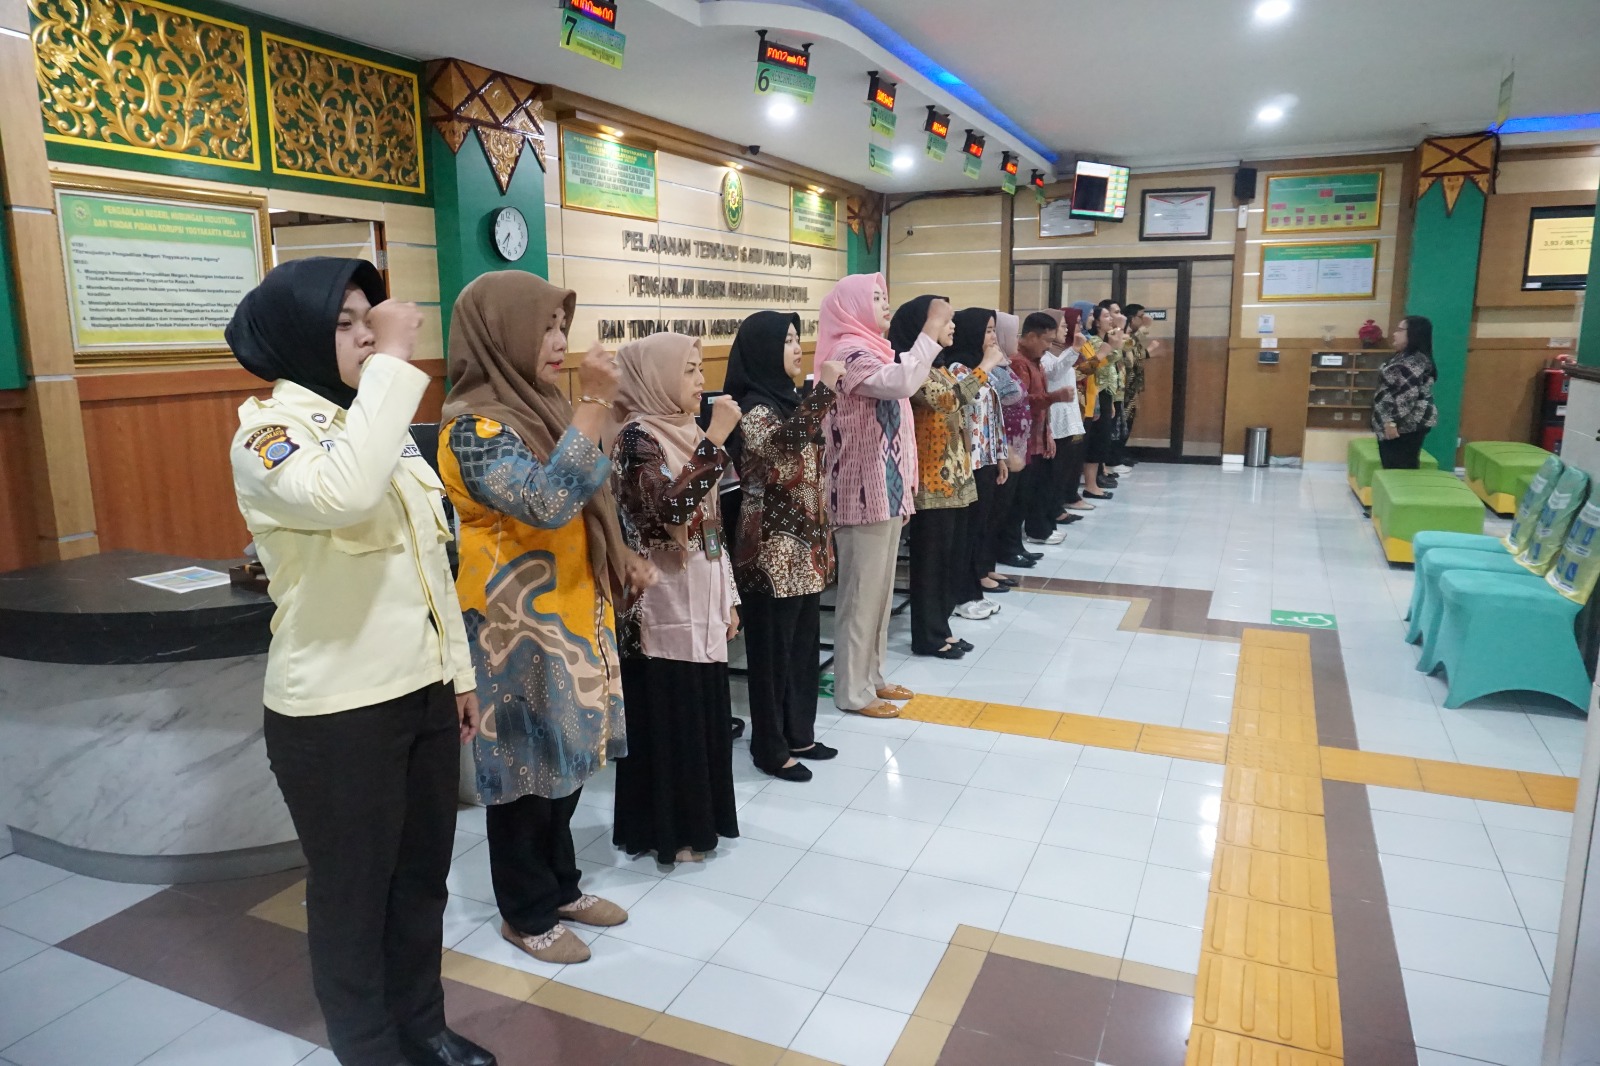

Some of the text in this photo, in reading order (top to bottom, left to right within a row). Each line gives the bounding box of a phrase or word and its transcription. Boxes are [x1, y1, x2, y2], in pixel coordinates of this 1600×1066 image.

[565, 15, 577, 46] 7
[758, 68, 770, 92] 6
[871, 107, 877, 127] 5
[870, 148, 876, 167] 5
[103, 205, 145, 216] PENGADILAN
[171, 212, 203, 222] HUBUNGAN
[204, 215, 236, 225] INDUSTRIAL
[93, 217, 107, 227] DAN
[109, 220, 133, 229] TINDAK
[135, 221, 157, 231] PIDANA
[158, 224, 184, 233] KORUPSI
[185, 226, 222, 236] YOGYAKARTA
[222, 230, 240, 238] KELAS
[622, 230, 691, 257] PELAYANAN
[693, 240, 739, 262] TERPADU
[740, 246, 763, 264] SATU
[763, 249, 788, 267] PINTU
[629, 274, 694, 299] PENGADILAN
[598, 319, 625, 343] DAN
[626, 319, 671, 341] TINDAK
[671, 319, 707, 338] PIDANA
[248, 427, 282, 444] POLDA
